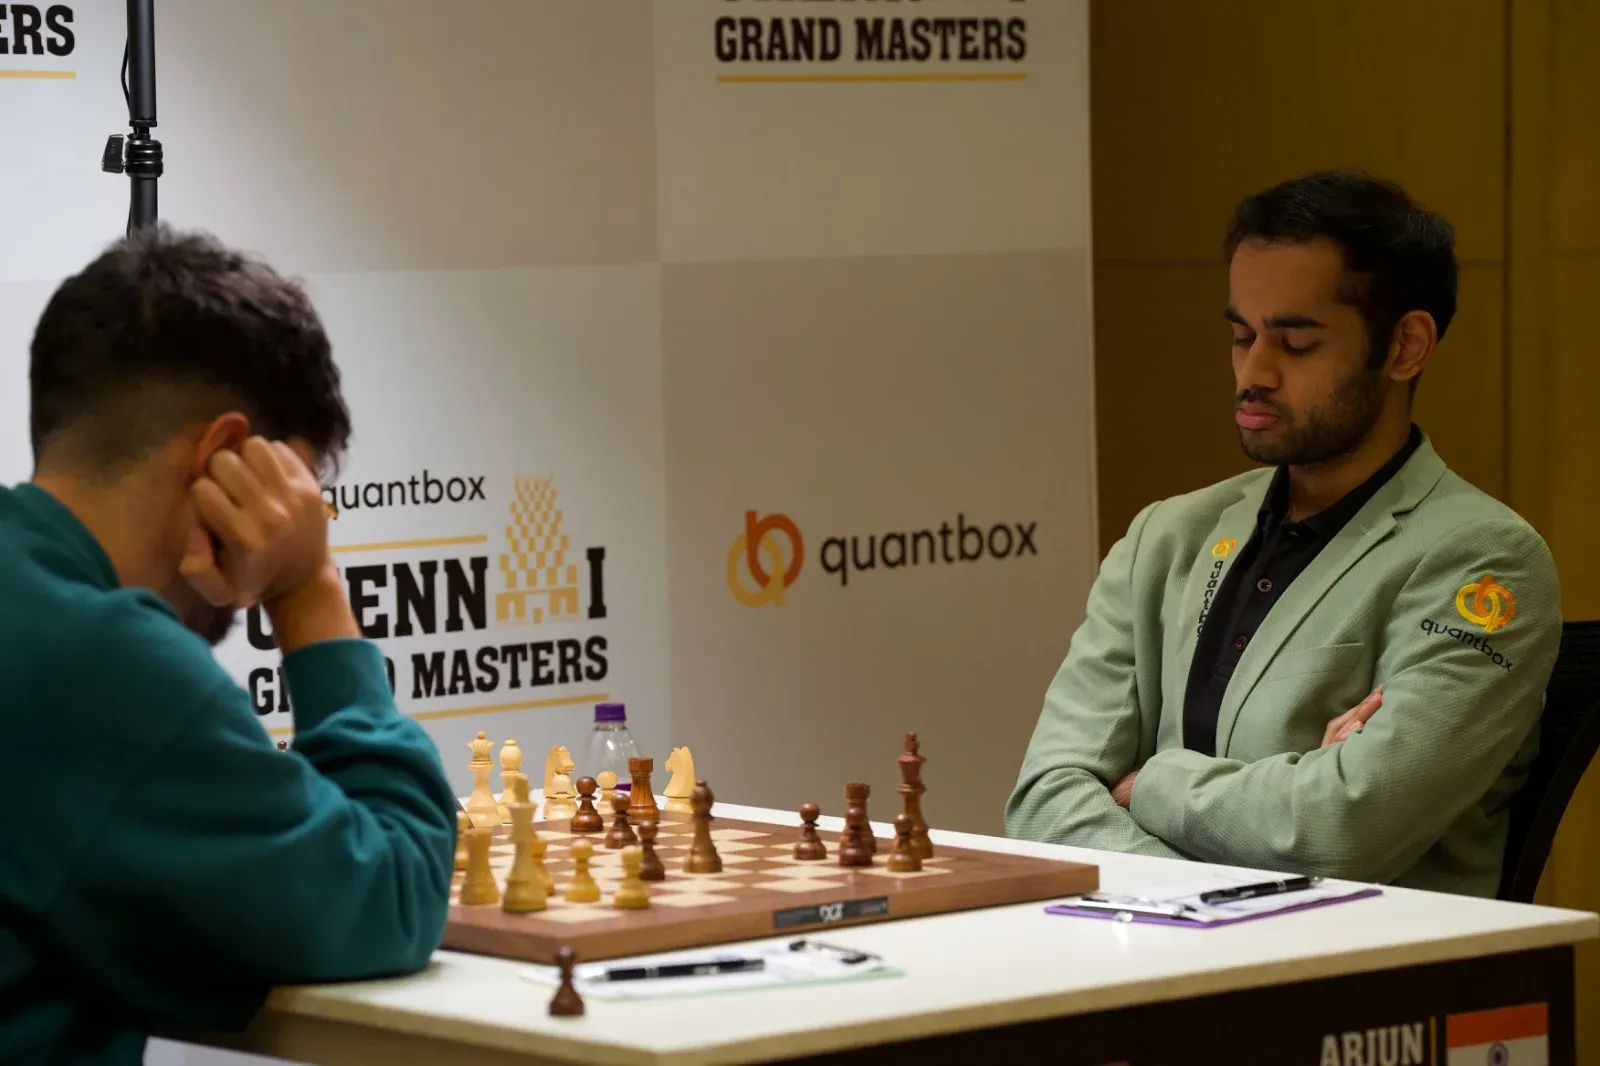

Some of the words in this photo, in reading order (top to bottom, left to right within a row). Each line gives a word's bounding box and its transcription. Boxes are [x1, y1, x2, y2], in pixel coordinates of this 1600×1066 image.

[714, 16, 842, 63] GRAND
[854, 17, 1027, 62] MASTERS
[321, 470, 486, 521] quantbox
[820, 512, 1038, 587] quantbox
[411, 636, 609, 699] MASTERS
[1421, 618, 1513, 672] quantbox
[1320, 1022, 1424, 1066] ARJUN
